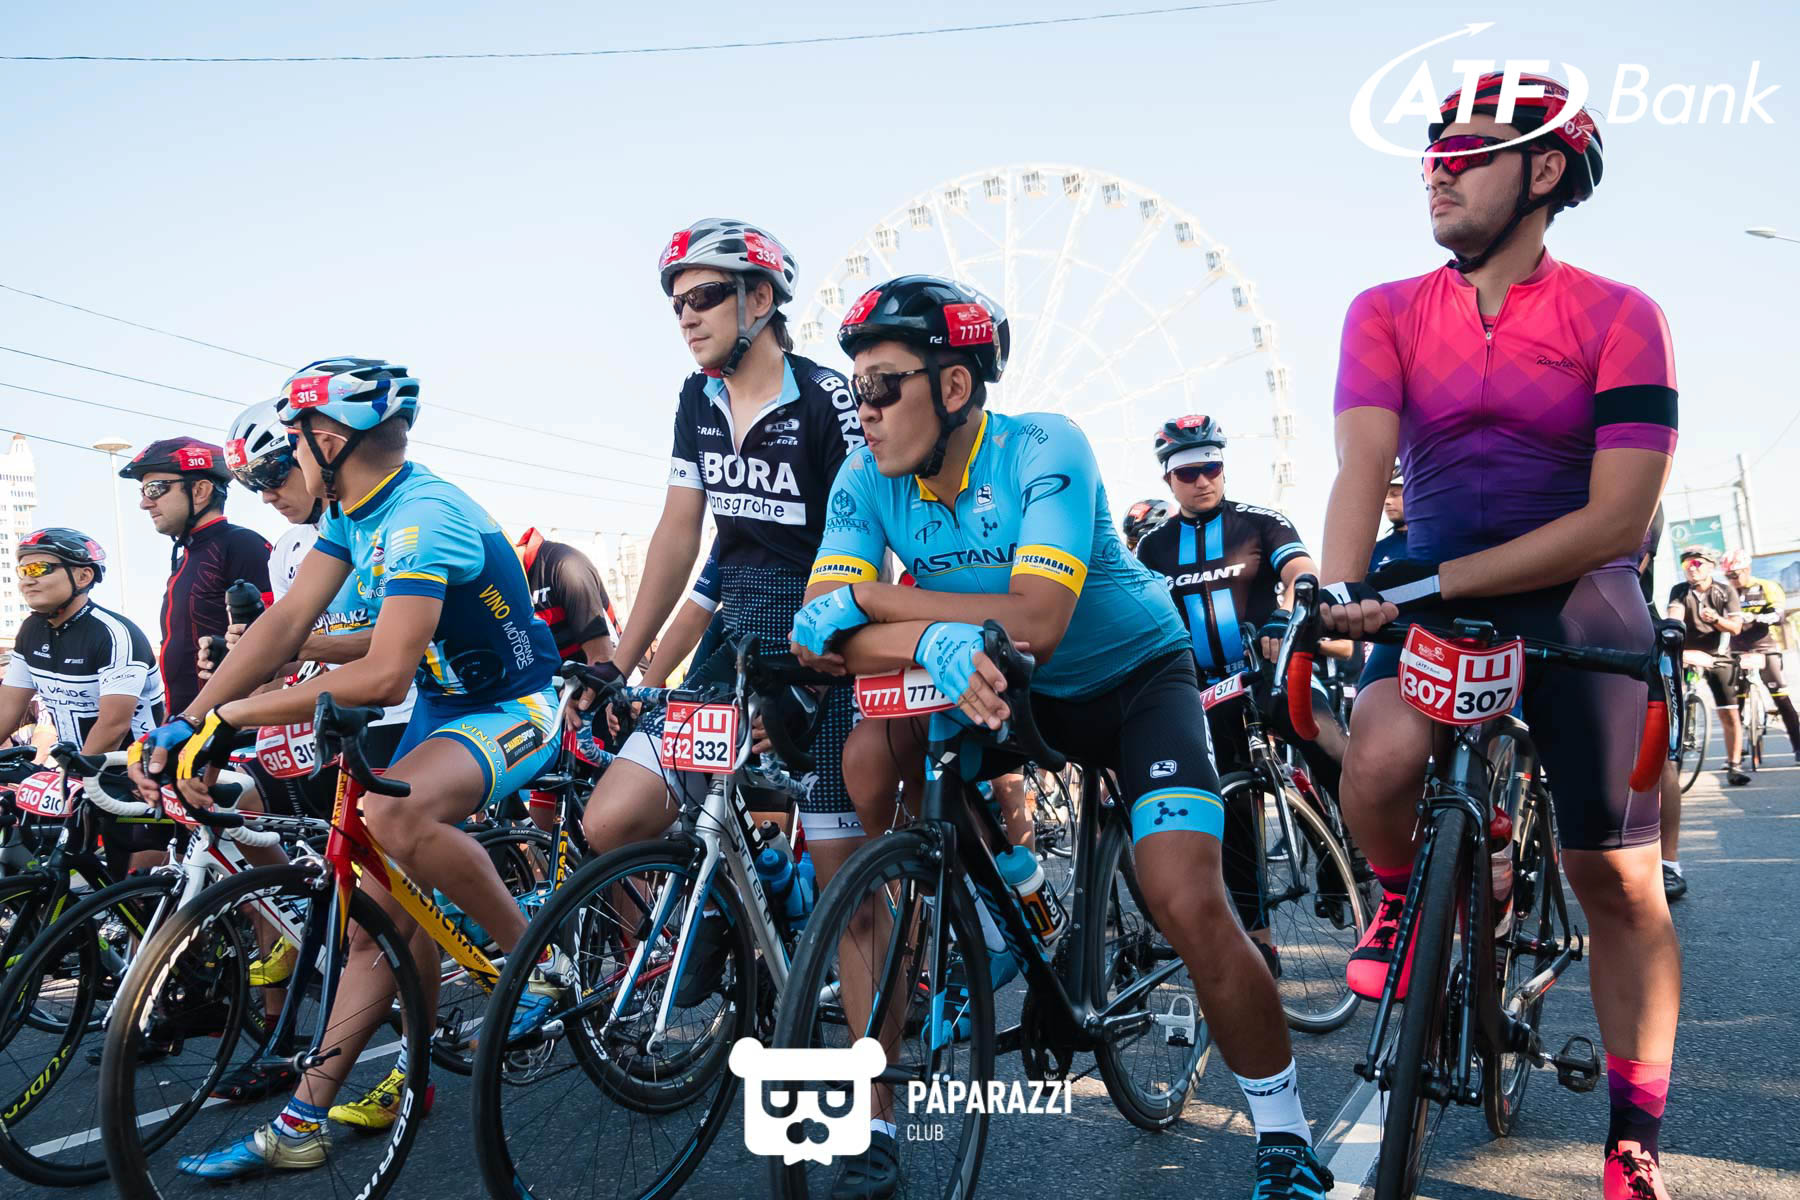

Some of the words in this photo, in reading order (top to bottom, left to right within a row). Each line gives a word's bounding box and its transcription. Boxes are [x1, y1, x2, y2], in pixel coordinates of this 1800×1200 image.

[1560, 120, 1582, 139] 07
[756, 249, 777, 264] 332
[960, 324, 987, 340] 7777
[297, 390, 318, 403] 315
[820, 376, 866, 456] BORA
[187, 457, 205, 467] 310
[704, 451, 801, 496] BORA
[1248, 504, 1292, 529] GIANT
[1175, 564, 1246, 587] GIANT
[479, 584, 511, 619] VINO
[502, 621, 528, 670] MOTORS
[519, 630, 535, 665] ASTANA
[861, 687, 901, 707] 7777
[1216, 678, 1235, 696] 377
[1404, 671, 1452, 710] 307
[1456, 687, 1513, 714] 307
[461, 723, 497, 752] VINO
[664, 736, 691, 760] 332
[262, 749, 292, 771] 315
[694, 740, 728, 762] 332
[18, 787, 41, 806] 310
[1041, 885, 1060, 926] Tacx
